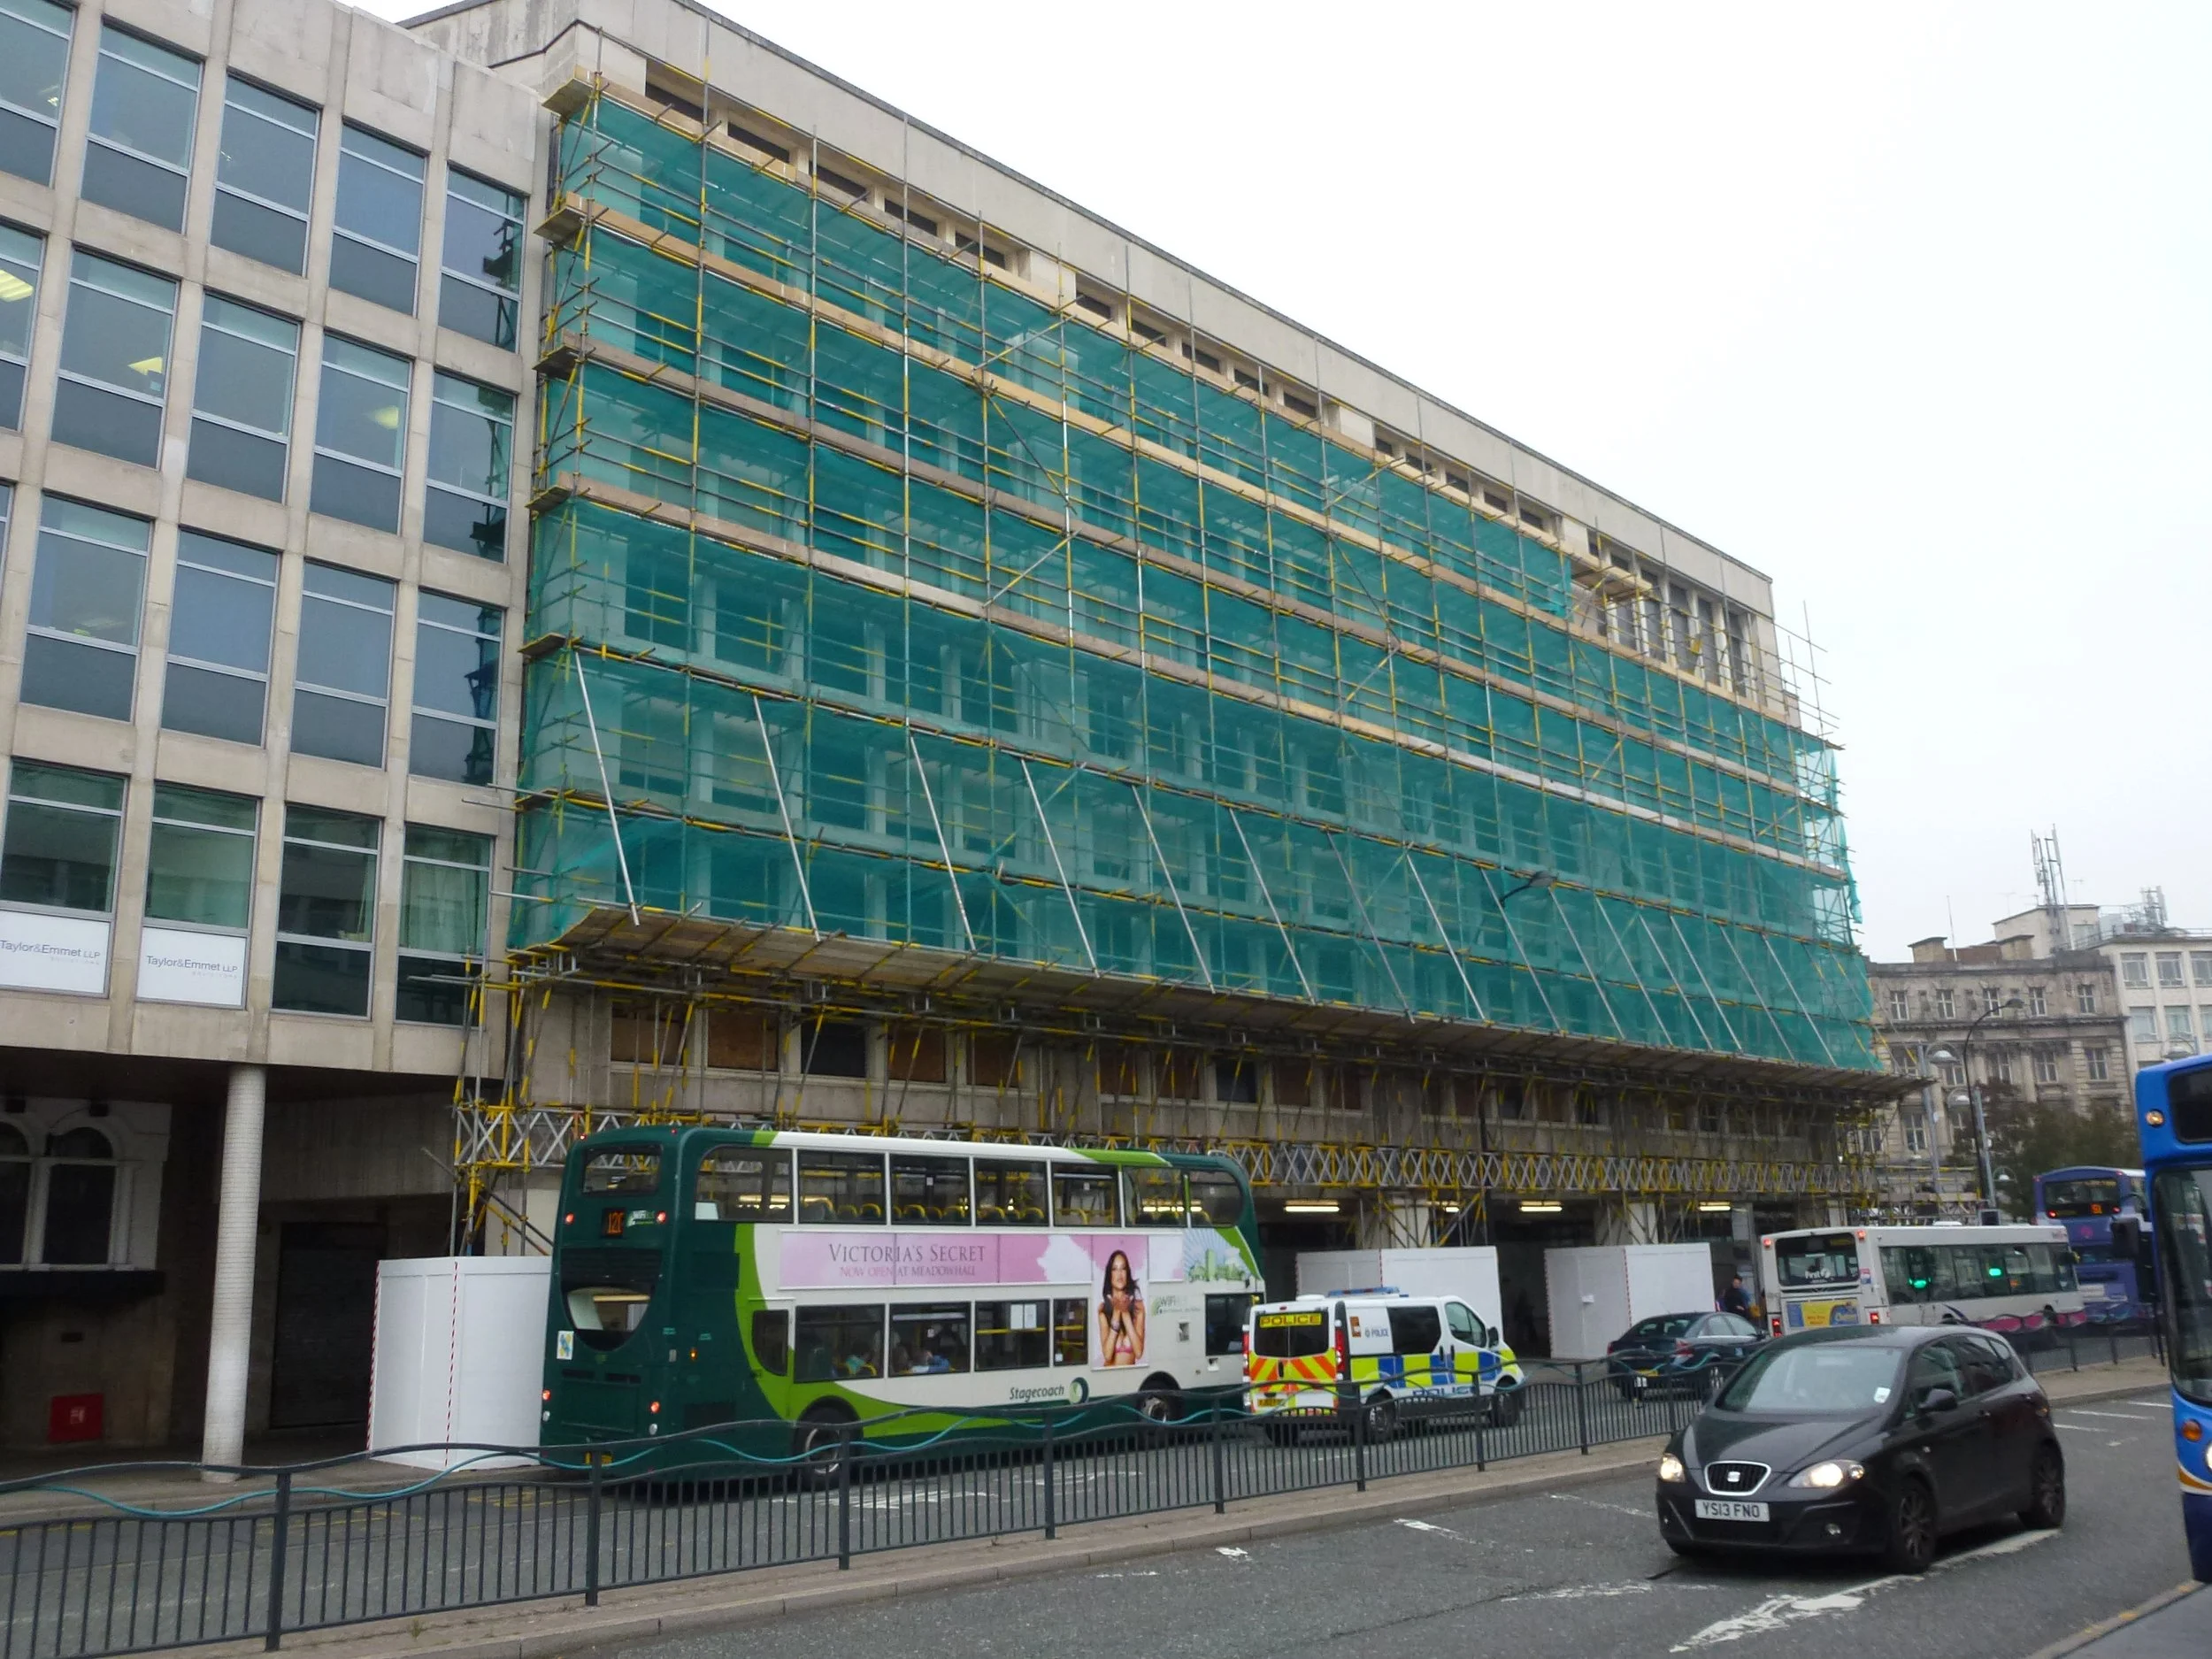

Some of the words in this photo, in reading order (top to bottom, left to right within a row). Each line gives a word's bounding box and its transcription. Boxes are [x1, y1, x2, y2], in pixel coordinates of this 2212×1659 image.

[0, 940, 81, 957] Taylor&Emmet
[83, 950, 101, 959] LLP
[146, 955, 220, 972] Taylor&Emmet
[829, 1243, 923, 1263] VICTORIA'S
[930, 1244, 986, 1262] SECRET
[840, 1266, 864, 1278] NOW
[867, 1266, 894, 1278] OPEN
[897, 1265, 909, 1277] AT
[911, 1264, 976, 1277] MEADOWHALL
[1260, 1315, 1320, 1326] POLICE
[1009, 1384, 1065, 1403] Stagecoach
[1702, 1502, 1731, 1517] YS13
[1733, 1503, 1761, 1518] FNO
